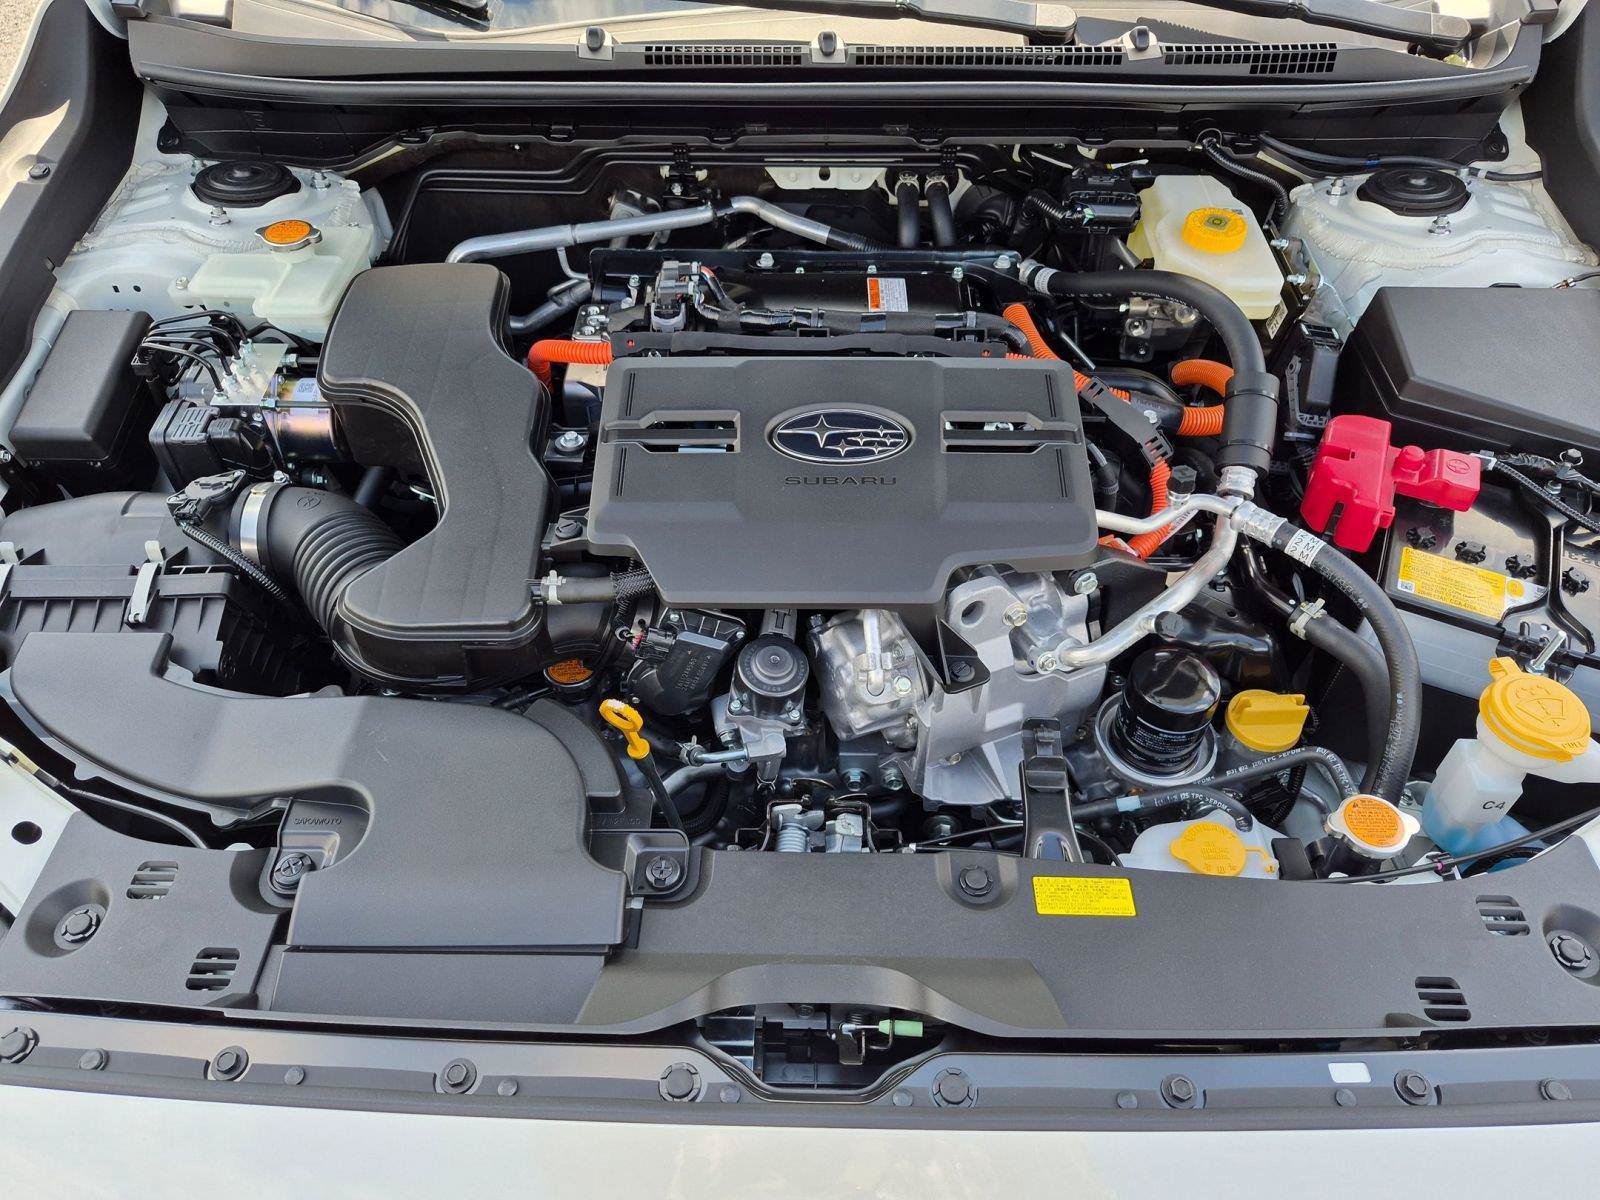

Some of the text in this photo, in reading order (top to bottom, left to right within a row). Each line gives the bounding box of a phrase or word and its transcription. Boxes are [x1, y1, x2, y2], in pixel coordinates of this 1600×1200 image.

[784, 476, 897, 485] SUBARU
[1294, 538, 1315, 553] 2 M
[1290, 545, 1309, 560] 2 M
[1482, 800, 1505, 811] C4
